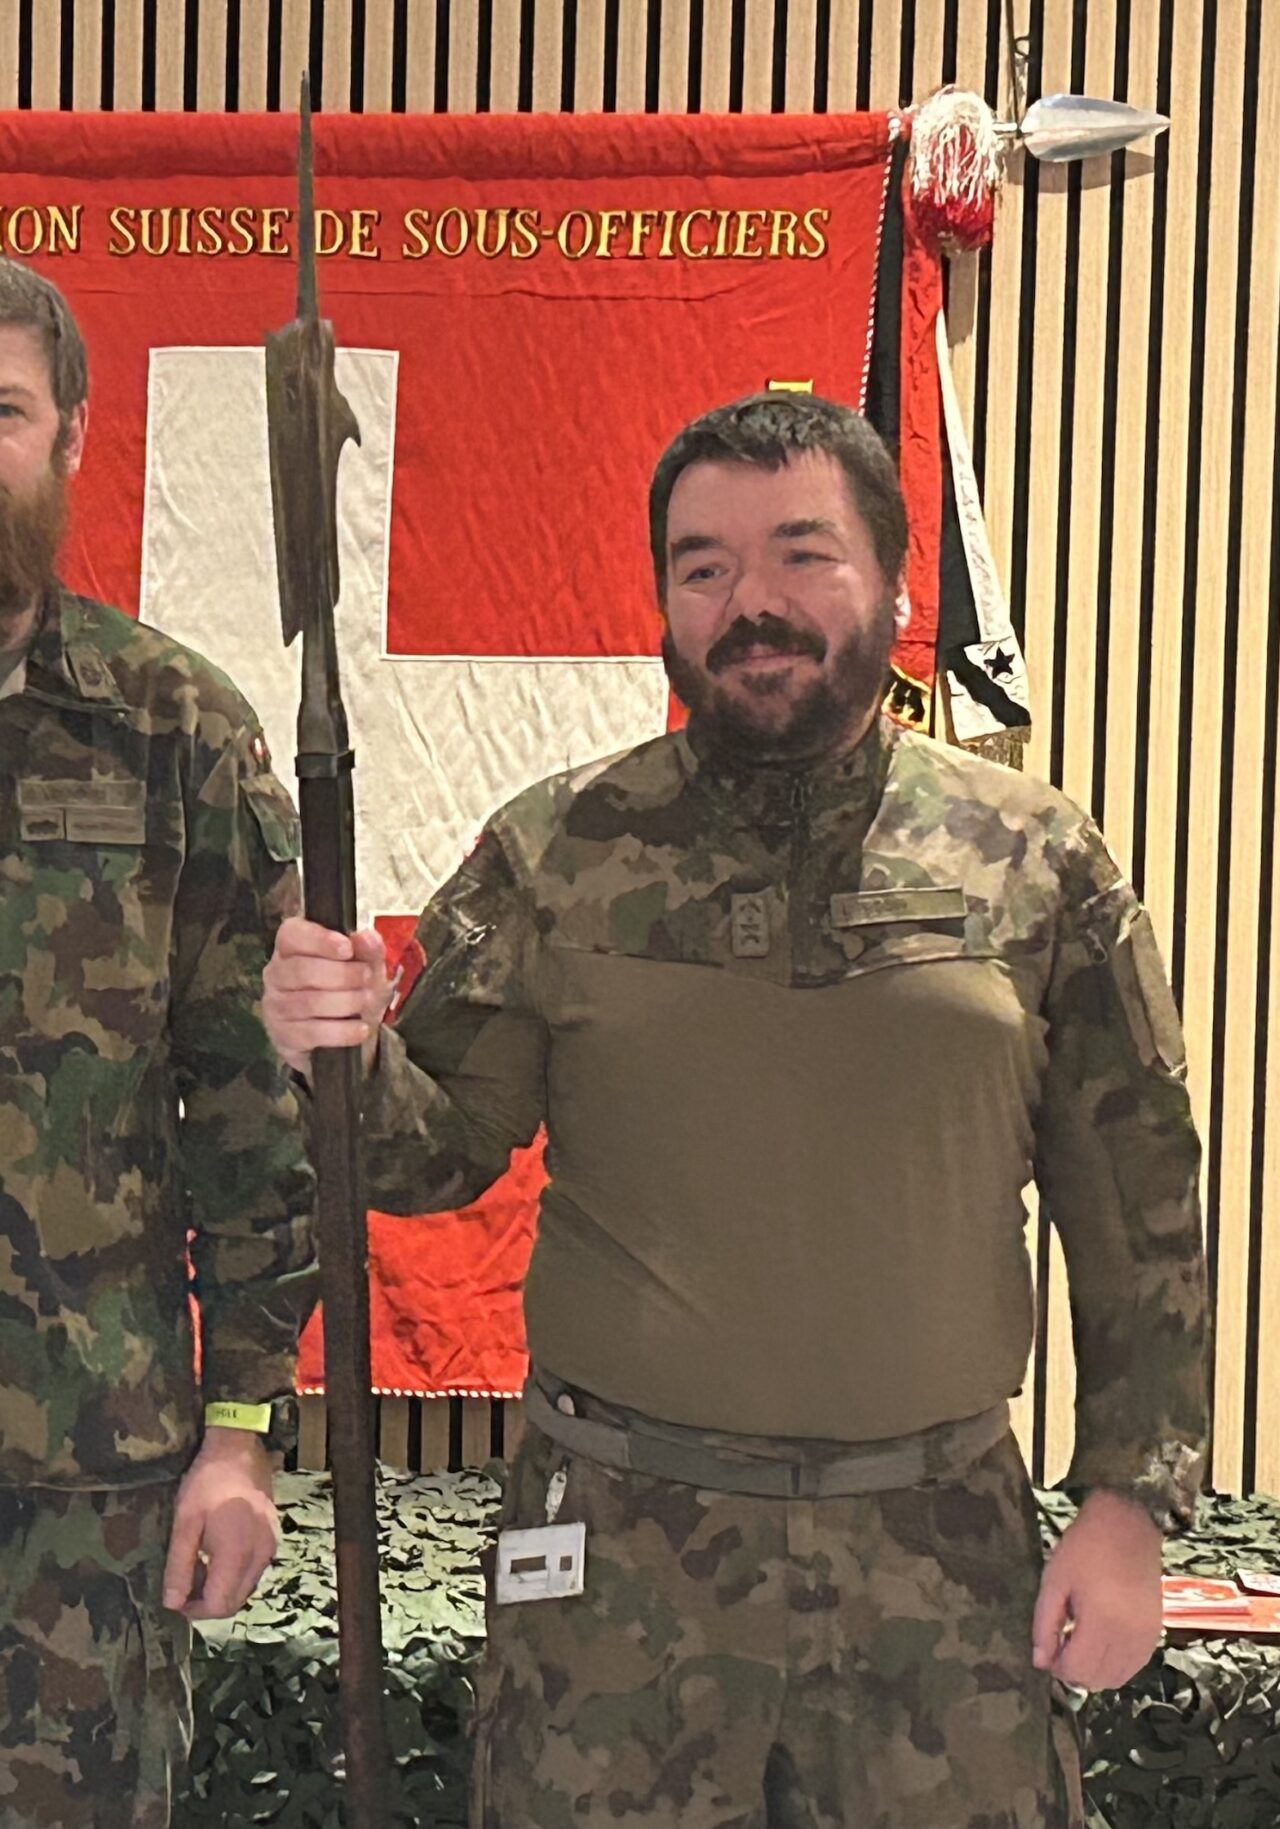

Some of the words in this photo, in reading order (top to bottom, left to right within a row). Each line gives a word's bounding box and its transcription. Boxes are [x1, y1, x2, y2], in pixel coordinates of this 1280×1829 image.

[108, 206, 290, 256] SUISSE
[314, 209, 380, 258] DE
[402, 206, 831, 259] SOUS-OFFICIERS
